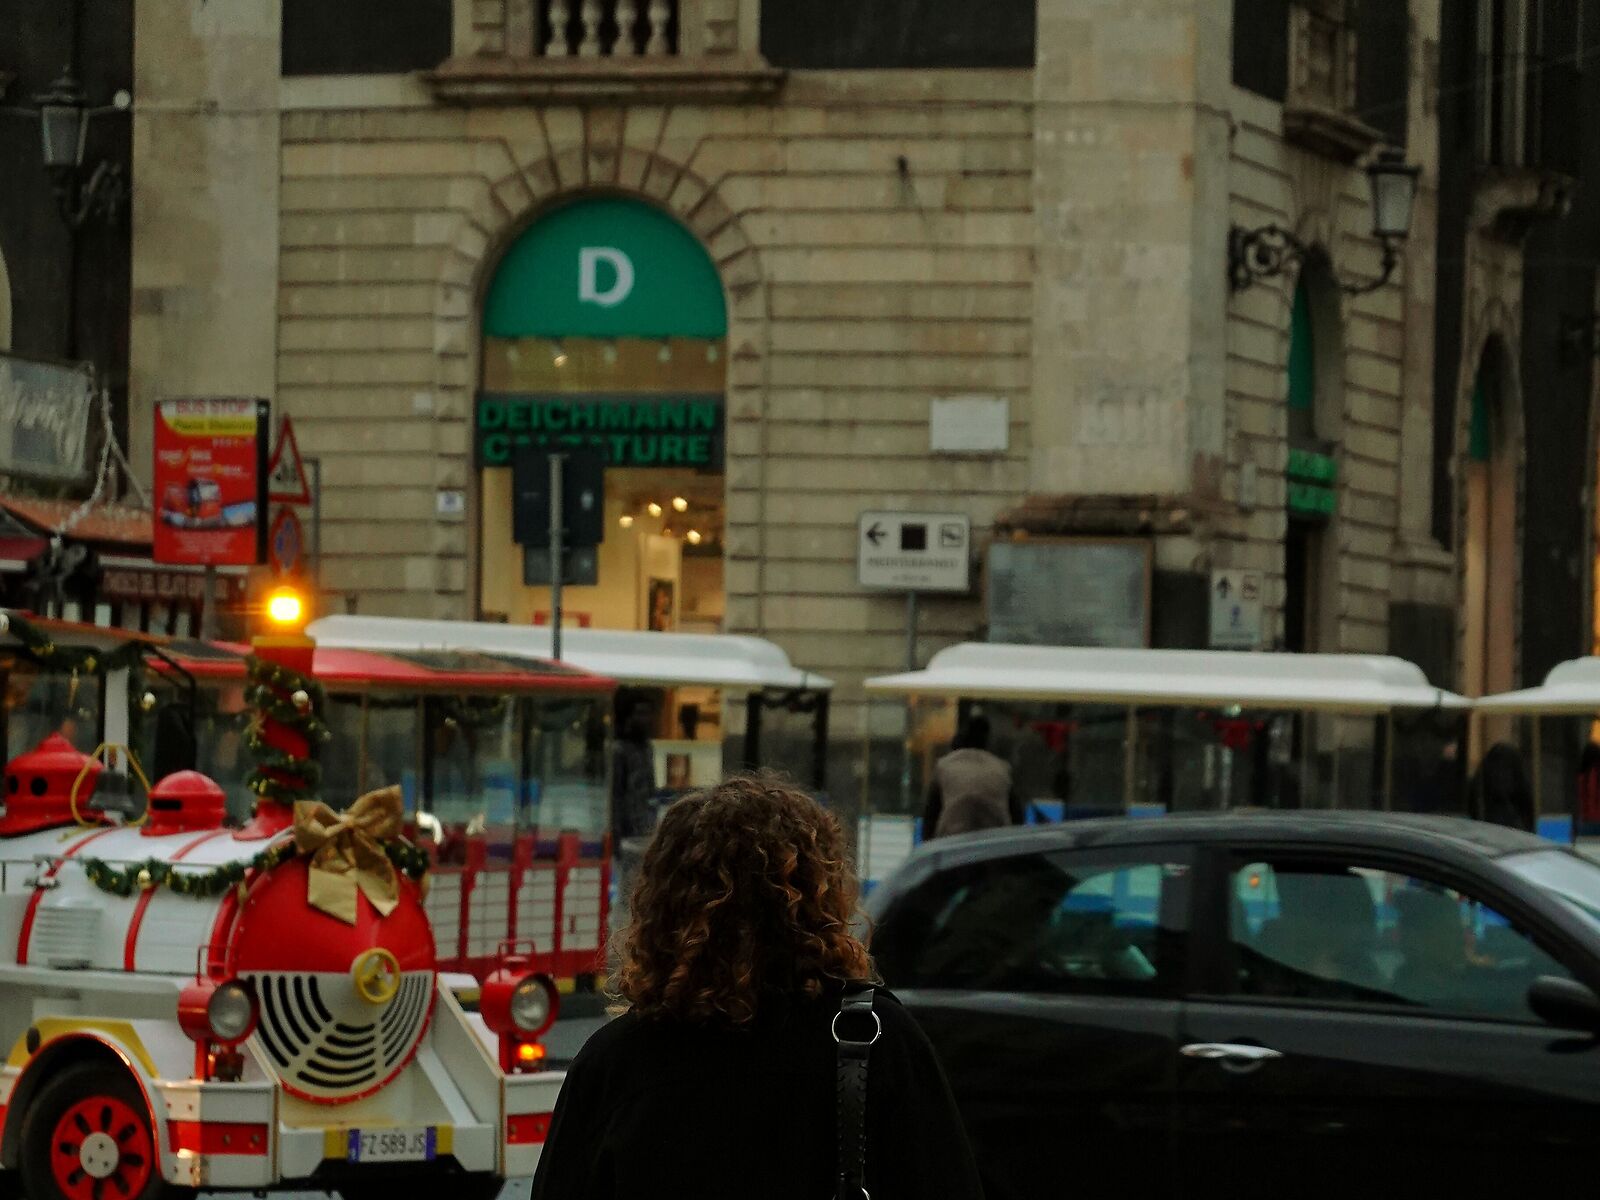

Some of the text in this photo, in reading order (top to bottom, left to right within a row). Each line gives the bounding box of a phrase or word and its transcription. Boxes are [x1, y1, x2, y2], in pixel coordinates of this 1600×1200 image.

[577, 247, 636, 307] D
[209, 400, 249, 413] STOP
[478, 400, 718, 432] DEICHMANN
[361, 1132, 378, 1155] FZ
[381, 1132, 407, 1155] 589
